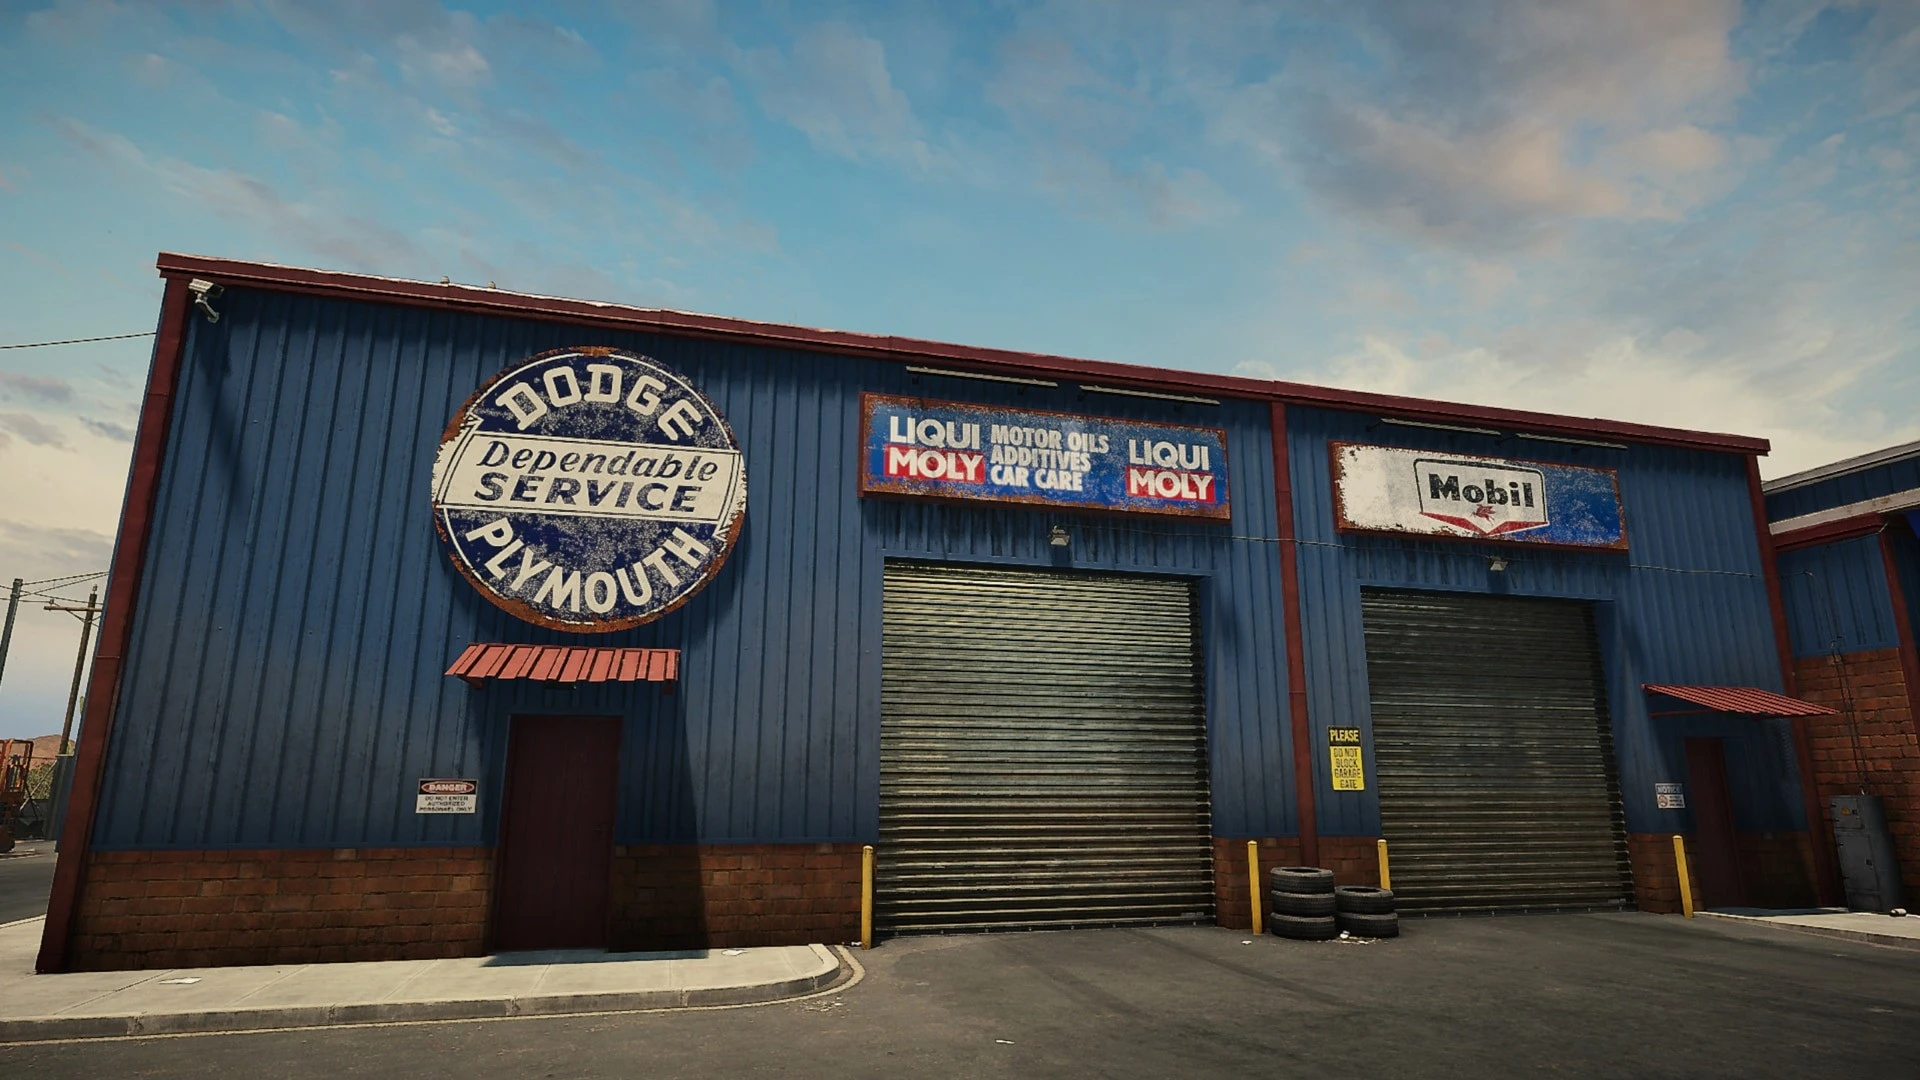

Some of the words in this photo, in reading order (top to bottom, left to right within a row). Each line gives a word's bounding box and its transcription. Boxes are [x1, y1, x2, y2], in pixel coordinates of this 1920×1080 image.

[496, 364, 702, 441] DODGE
[889, 415, 980, 450] LIQUI
[990, 424, 1062, 451] MOTOR
[1067, 431, 1110, 454] OILS
[476, 440, 718, 482] Dependable
[889, 448, 984, 482] MOLY
[990, 448, 1092, 473] ADDITIVES
[1128, 439, 1209, 471] LIQUI
[474, 472, 702, 513] SERVICE
[990, 466, 1030, 488] CAR
[1035, 469, 1084, 492] CARE
[1127, 467, 1213, 500] MOLY
[1428, 473, 1535, 508] Mobil
[465, 517, 709, 614] PLYMOUTH
[1329, 729, 1359, 742] PLEASE
[1333, 747, 1343, 758] DO
[1344, 747, 1358, 758] NOT
[1335, 758, 1359, 768] BLOCK
[1334, 768, 1362, 779] GARAGE
